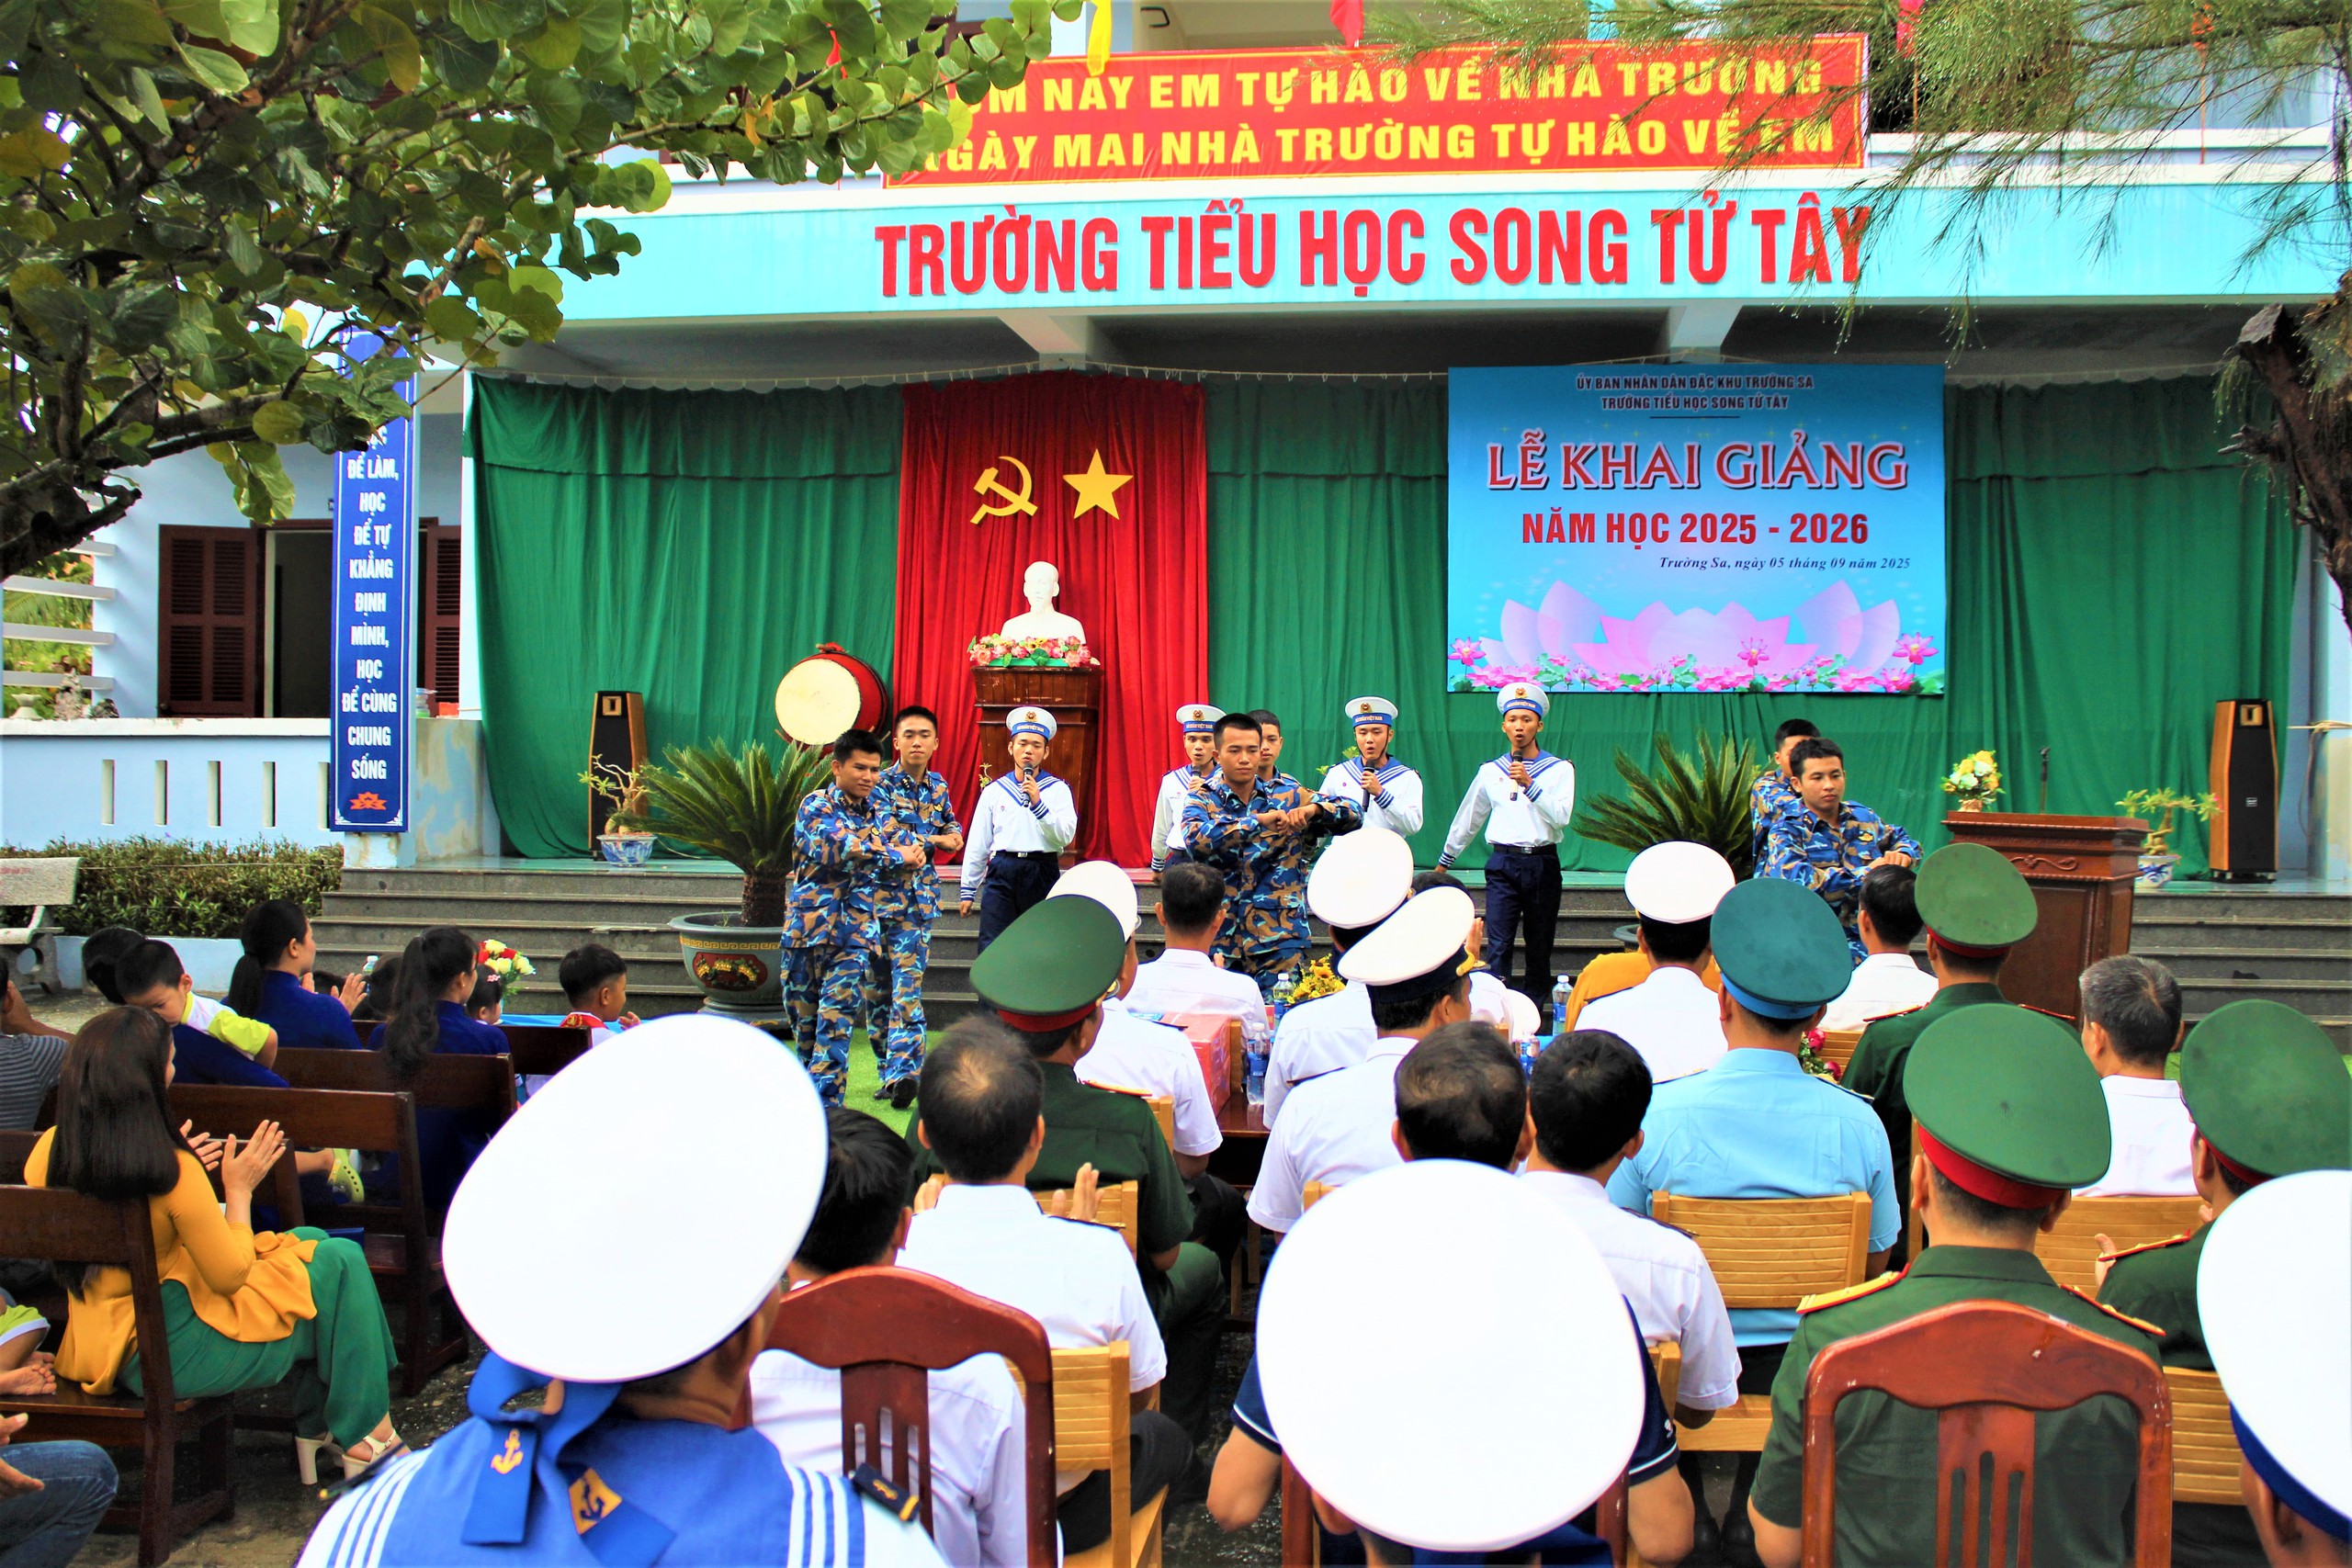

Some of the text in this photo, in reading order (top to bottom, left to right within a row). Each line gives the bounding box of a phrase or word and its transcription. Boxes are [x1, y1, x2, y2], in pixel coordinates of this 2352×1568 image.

[1043, 75, 1135, 111] NAY
[1150, 72, 1222, 109] EM
[1236, 67, 1299, 113] TỰ
[1310, 62, 1408, 105] HÀO
[1424, 55, 1482, 101] VỀ
[1054, 131, 1145, 168] MAI
[1161, 122, 1261, 164] NHÀ
[1275, 118, 1475, 163] TRƯỜNG
[1491, 118, 1556, 165] TỰ
[1567, 113, 1667, 157] HÀO
[1682, 107, 1741, 154] VỀ
[1758, 118, 1834, 152] EM
[875, 189, 1871, 298] TRƯỜNG TIỂU HỌC SONG TỬ TÂY
[1577, 372, 1815, 391] ỦY BAN NHÂN DÂN ĐẶC KHU TRƯỜNG SA
[1601, 393, 1651, 410] TRƯỜNG
[1682, 395, 1709, 412] HỌC
[1711, 395, 1745, 410] SONG
[1765, 393, 1790, 410] TÂY
[365, 425, 388, 450] ỌC
[347, 451, 399, 481] ĐỂ LÀM,
[1487, 426, 1909, 491] LỄ KHAI GIẢNG
[359, 492, 386, 516] HỌC
[354, 518, 391, 550] ĐỂ TỰ
[1522, 506, 1596, 544] NĂM
[1606, 512, 1669, 551] HỌC
[1679, 513, 1758, 544] 2025
[1790, 513, 1870, 544] 2026
[349, 549, 394, 579] KHẲNG
[1659, 557, 1911, 570] Trường Sa, ngày 05 tháng 09 năm 2025
[355, 592, 387, 617] ĐỊNH
[351, 622, 390, 648] MÌNH,
[356, 659, 383, 683] HỌC
[342, 684, 397, 713] ĐỂ CÙNG
[347, 726, 390, 747] CHUNG
[351, 752, 387, 780] SỐNG
